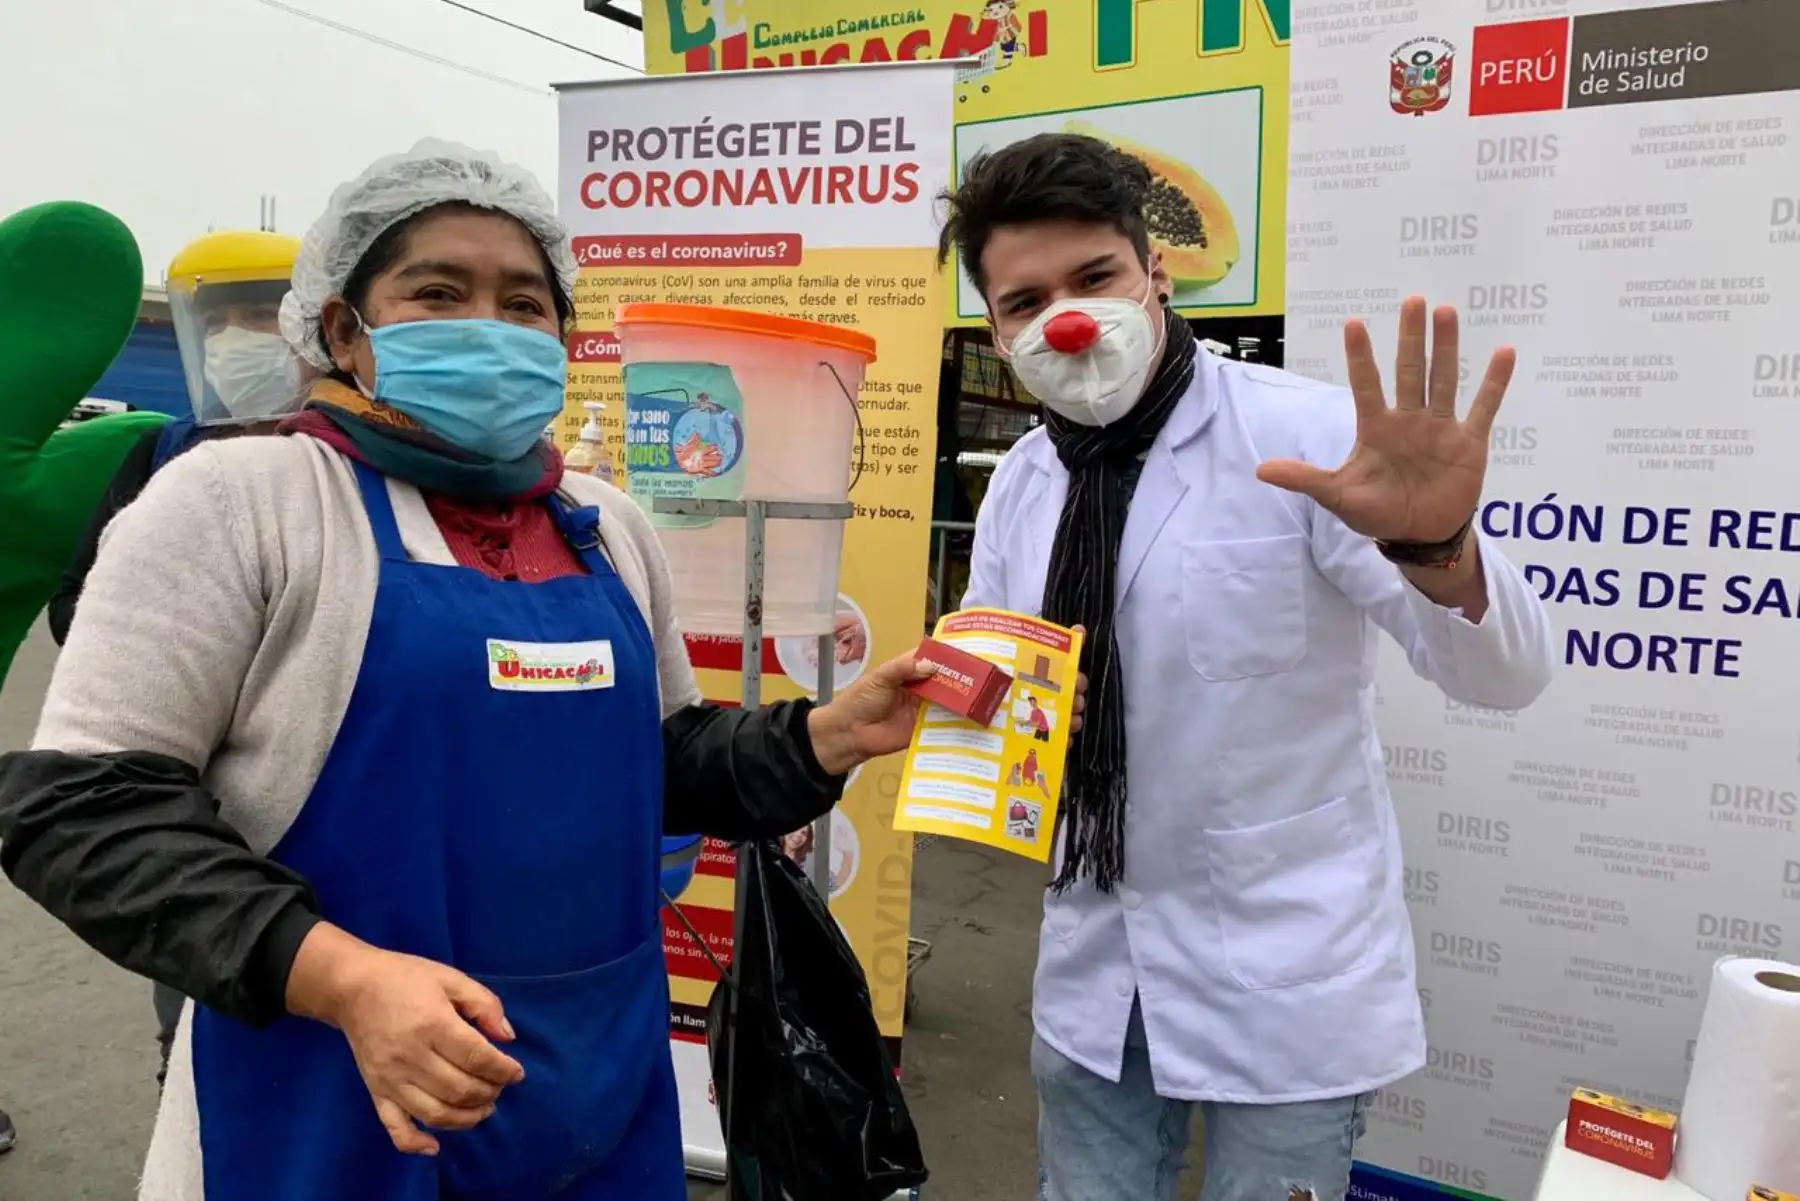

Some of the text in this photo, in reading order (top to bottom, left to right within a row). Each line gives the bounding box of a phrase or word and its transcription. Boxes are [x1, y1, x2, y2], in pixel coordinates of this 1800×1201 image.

[1581, 41, 1709, 73] Ministerio
[1480, 50, 1557, 87] PERÚ
[1578, 66, 1686, 95] de Salud
[1715, 120, 1733, 133] DE
[587, 116, 915, 163] PROTÉGETE DEL
[1477, 135, 1558, 164] DIRIS
[1718, 136, 1736, 149] DE
[580, 163, 920, 210] CORONAVIRUS
[1625, 204, 1642, 217] DE
[1400, 214, 1478, 242] DIRIS
[1629, 221, 1646, 232] DE
[577, 241, 788, 264] ¿Qué es el coronavirus?
[591, 276, 657, 287] coronavirus
[662, 275, 694, 289] (CoV)
[698, 278, 720, 287] son
[725, 277, 747, 287] una
[751, 275, 793, 289] amplia
[797, 275, 839, 288] familia
[844, 274, 861, 288] de
[865, 276, 896, 288] virus
[901, 277, 926, 289] que
[1700, 278, 1717, 290] DE
[618, 293, 656, 303] causar
[665, 293, 713, 305] diversas
[722, 293, 788, 307] afecciones,
[799, 293, 836, 306] desde
[846, 293, 858, 306] el
[868, 293, 926, 306] resfriado
[1468, 284, 1547, 310] DIRIS
[1704, 294, 1721, 305] DE
[574, 310, 605, 320] omún
[566, 390, 603, 402] expulsa
[897, 382, 922, 394] que
[884, 424, 919, 439] están
[1686, 428, 1702, 439] DE
[871, 443, 919, 456] tipo de
[1689, 444, 1706, 455] DE
[884, 464, 892, 476] y
[897, 464, 918, 474] ser
[869, 507, 877, 519] y
[880, 505, 915, 521] boca,
[1481, 492, 1604, 542] CIÓN
[1622, 505, 1692, 546] DE
[1637, 570, 1707, 613] DE
[1565, 628, 1743, 679] NORTE
[1710, 783, 1797, 816] DIRIS
[1437, 812, 1511, 844] DIRIS
[665, 926, 681, 938] los
[709, 933, 719, 944] la
[1697, 914, 1782, 946] DIRIS
[687, 946, 701, 958] sin
[1431, 932, 1501, 963] DIRIS
[1426, 1046, 1493, 1078] DIRIS
[1579, 1119, 1656, 1151] PROTÉGETE DEL
[1418, 1156, 1486, 1190] DIRIS
